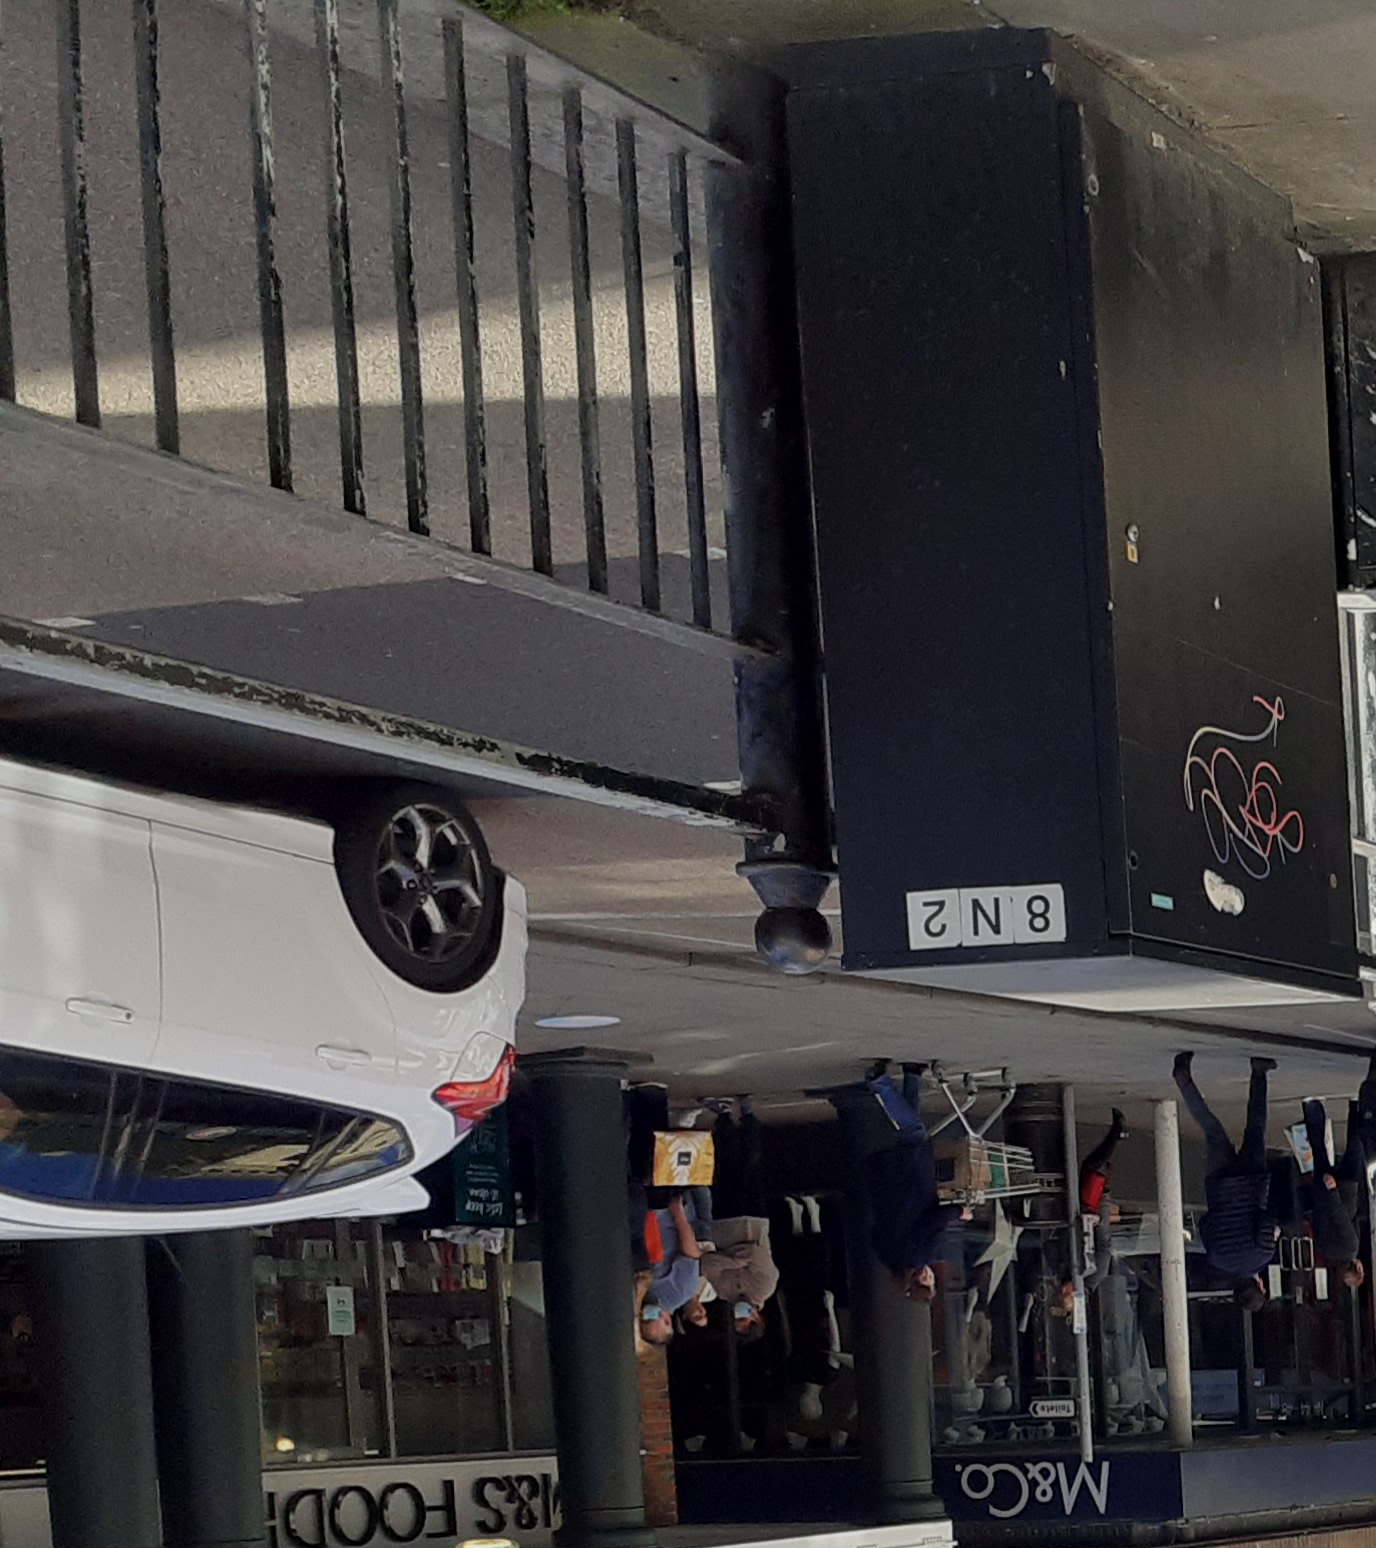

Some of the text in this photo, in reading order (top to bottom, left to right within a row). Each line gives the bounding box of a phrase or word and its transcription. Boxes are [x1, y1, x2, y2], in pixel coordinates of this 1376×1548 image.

[922, 895, 1050, 938] 8 N 2
[1040, 1404, 1071, 1413] Toilets
[954, 1460, 1110, 1518] M&Co.
